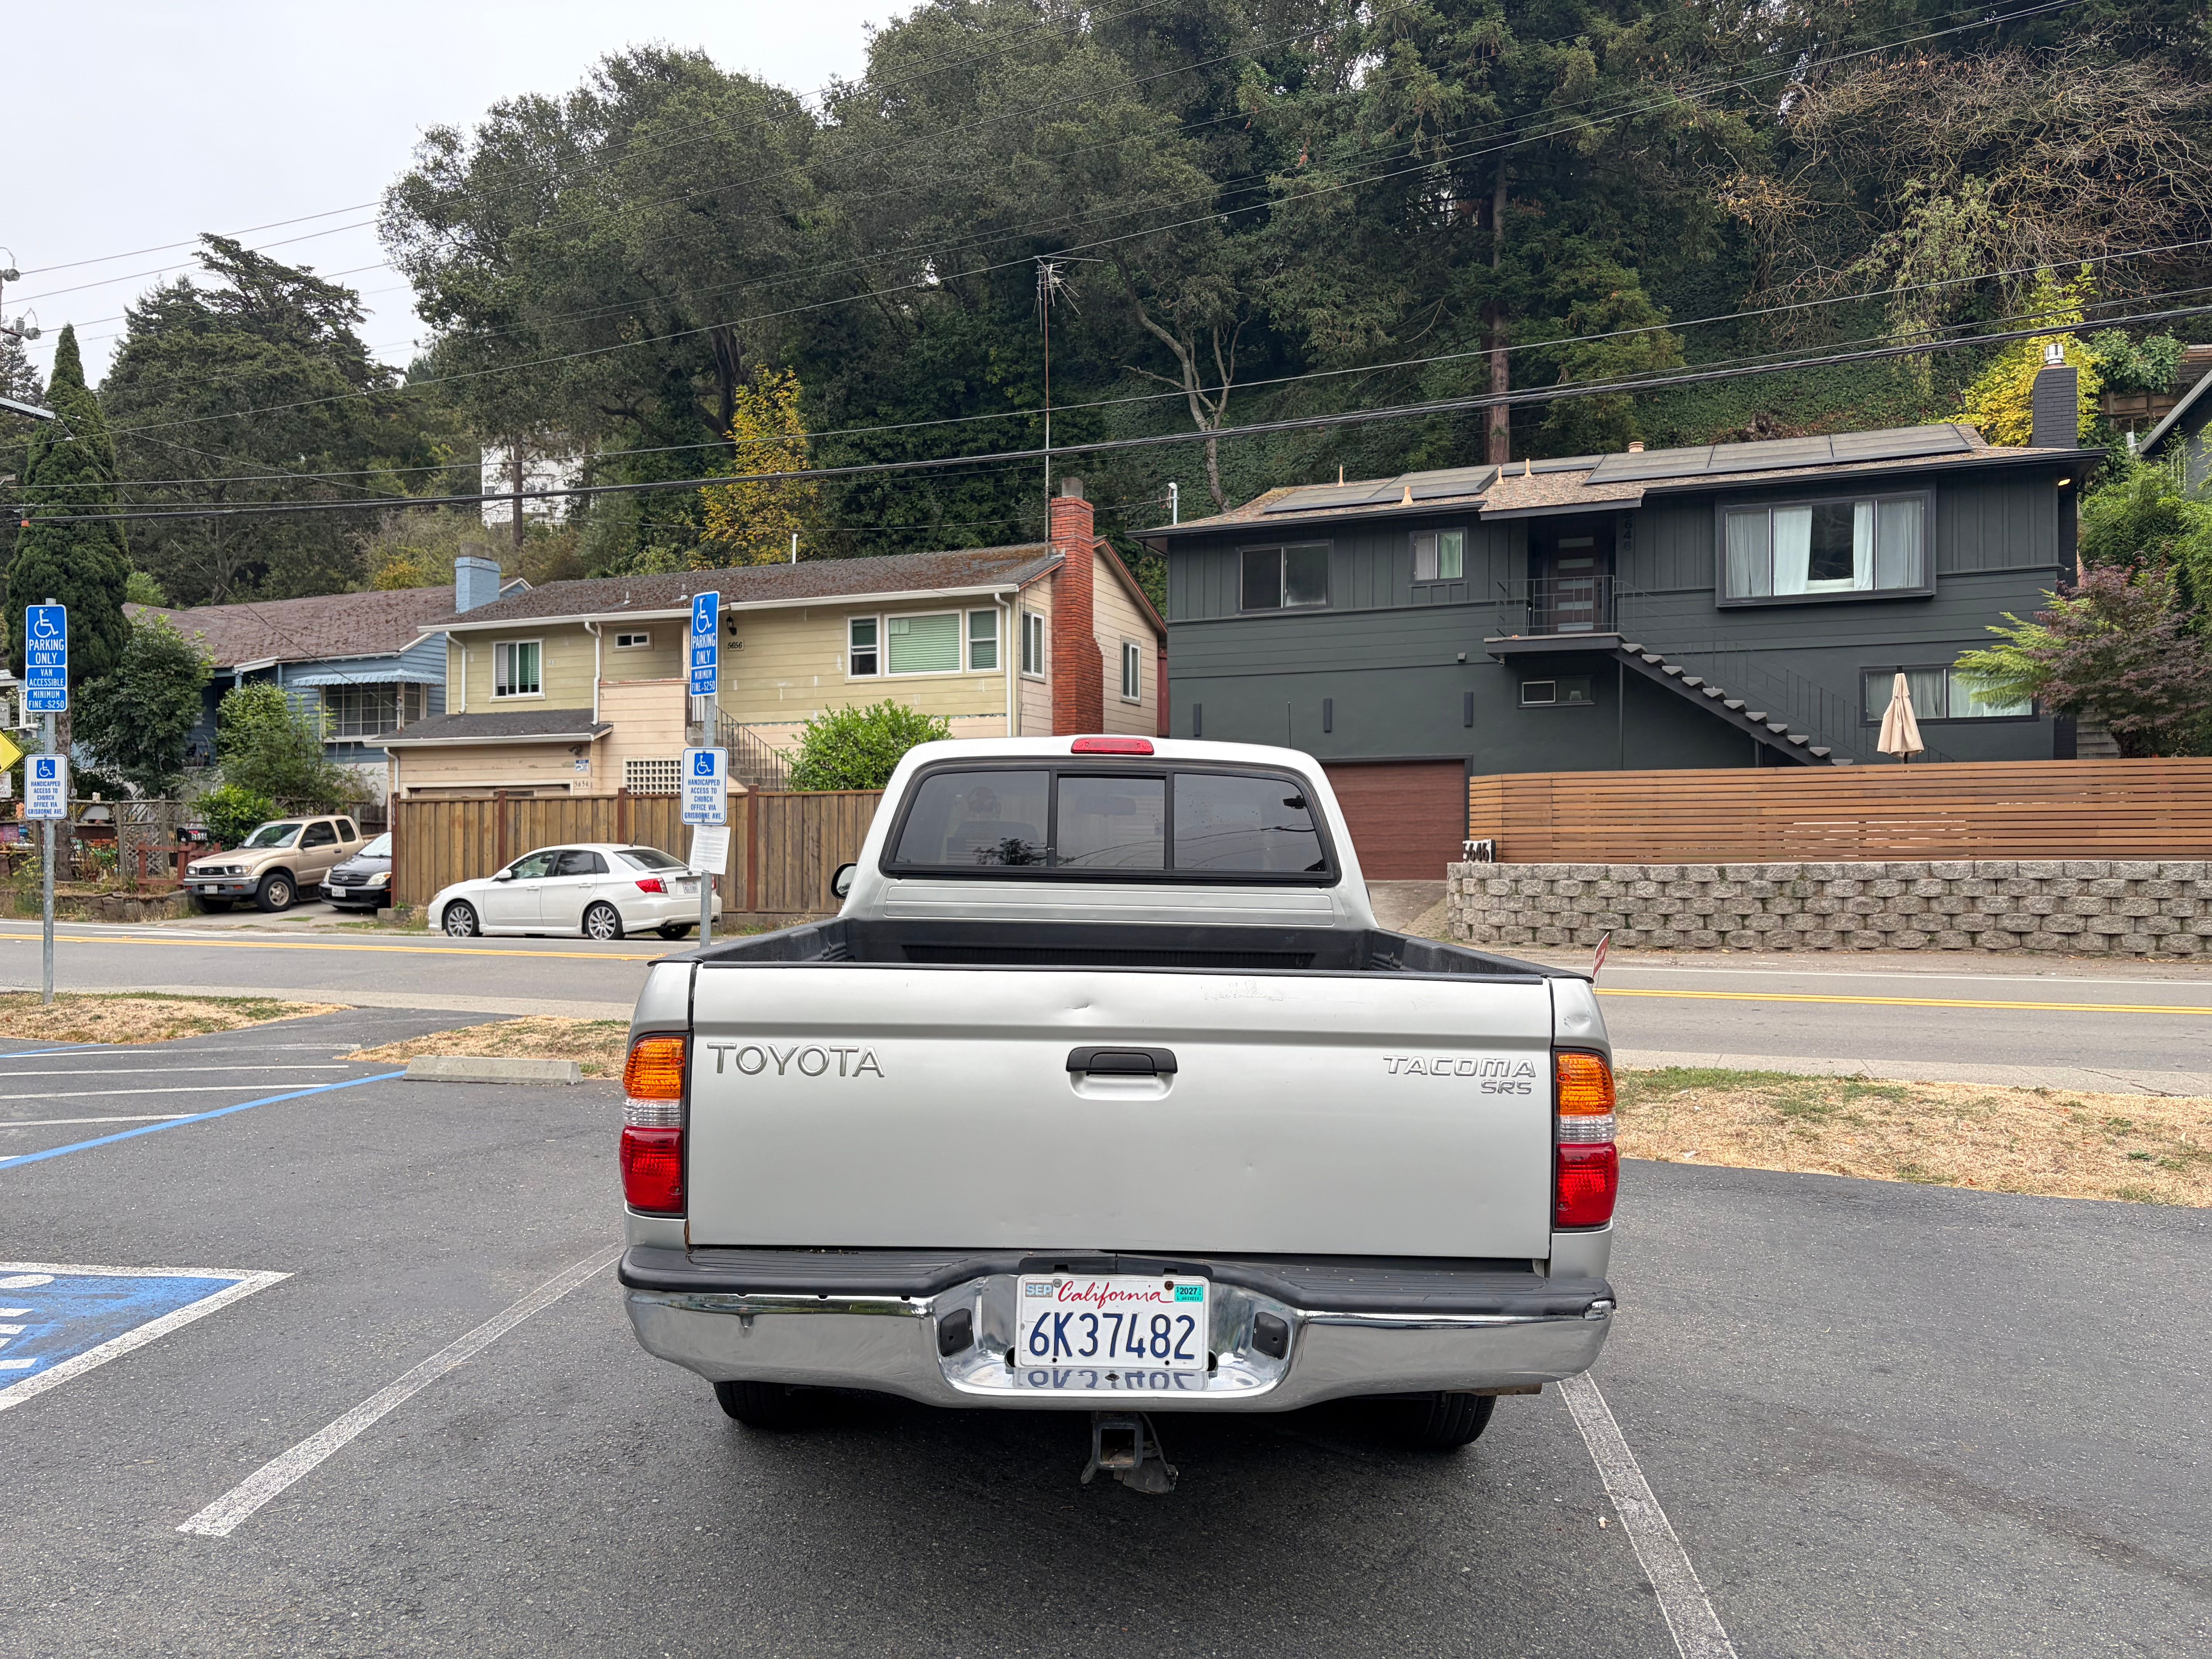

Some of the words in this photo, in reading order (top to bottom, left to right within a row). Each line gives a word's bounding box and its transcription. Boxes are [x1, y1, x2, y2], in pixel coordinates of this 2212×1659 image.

[29, 639, 64, 651] PARKING
[692, 632, 715, 650] PARKING
[35, 652, 57, 665] ONLY
[696, 649, 711, 665] ONLY
[40, 668, 53, 677] VAN
[695, 669, 713, 680] MINIMUM
[29, 678, 64, 687] ACCESSIBLE
[692, 682, 701, 693] FINE
[703, 680, 715, 692] $250
[33, 690, 60, 699] MINIMUM
[28, 700, 43, 709] FINE
[47, 700, 64, 709] $250
[707, 1042, 885, 1078] TOYOTA
[1383, 1055, 1536, 1078] TACOMA
[1026, 1284, 1052, 1296] SEP
[1058, 1280, 1174, 1309] California
[1180, 1287, 1198, 1295] 2027
[1029, 1312, 1195, 1360] 6K37482
